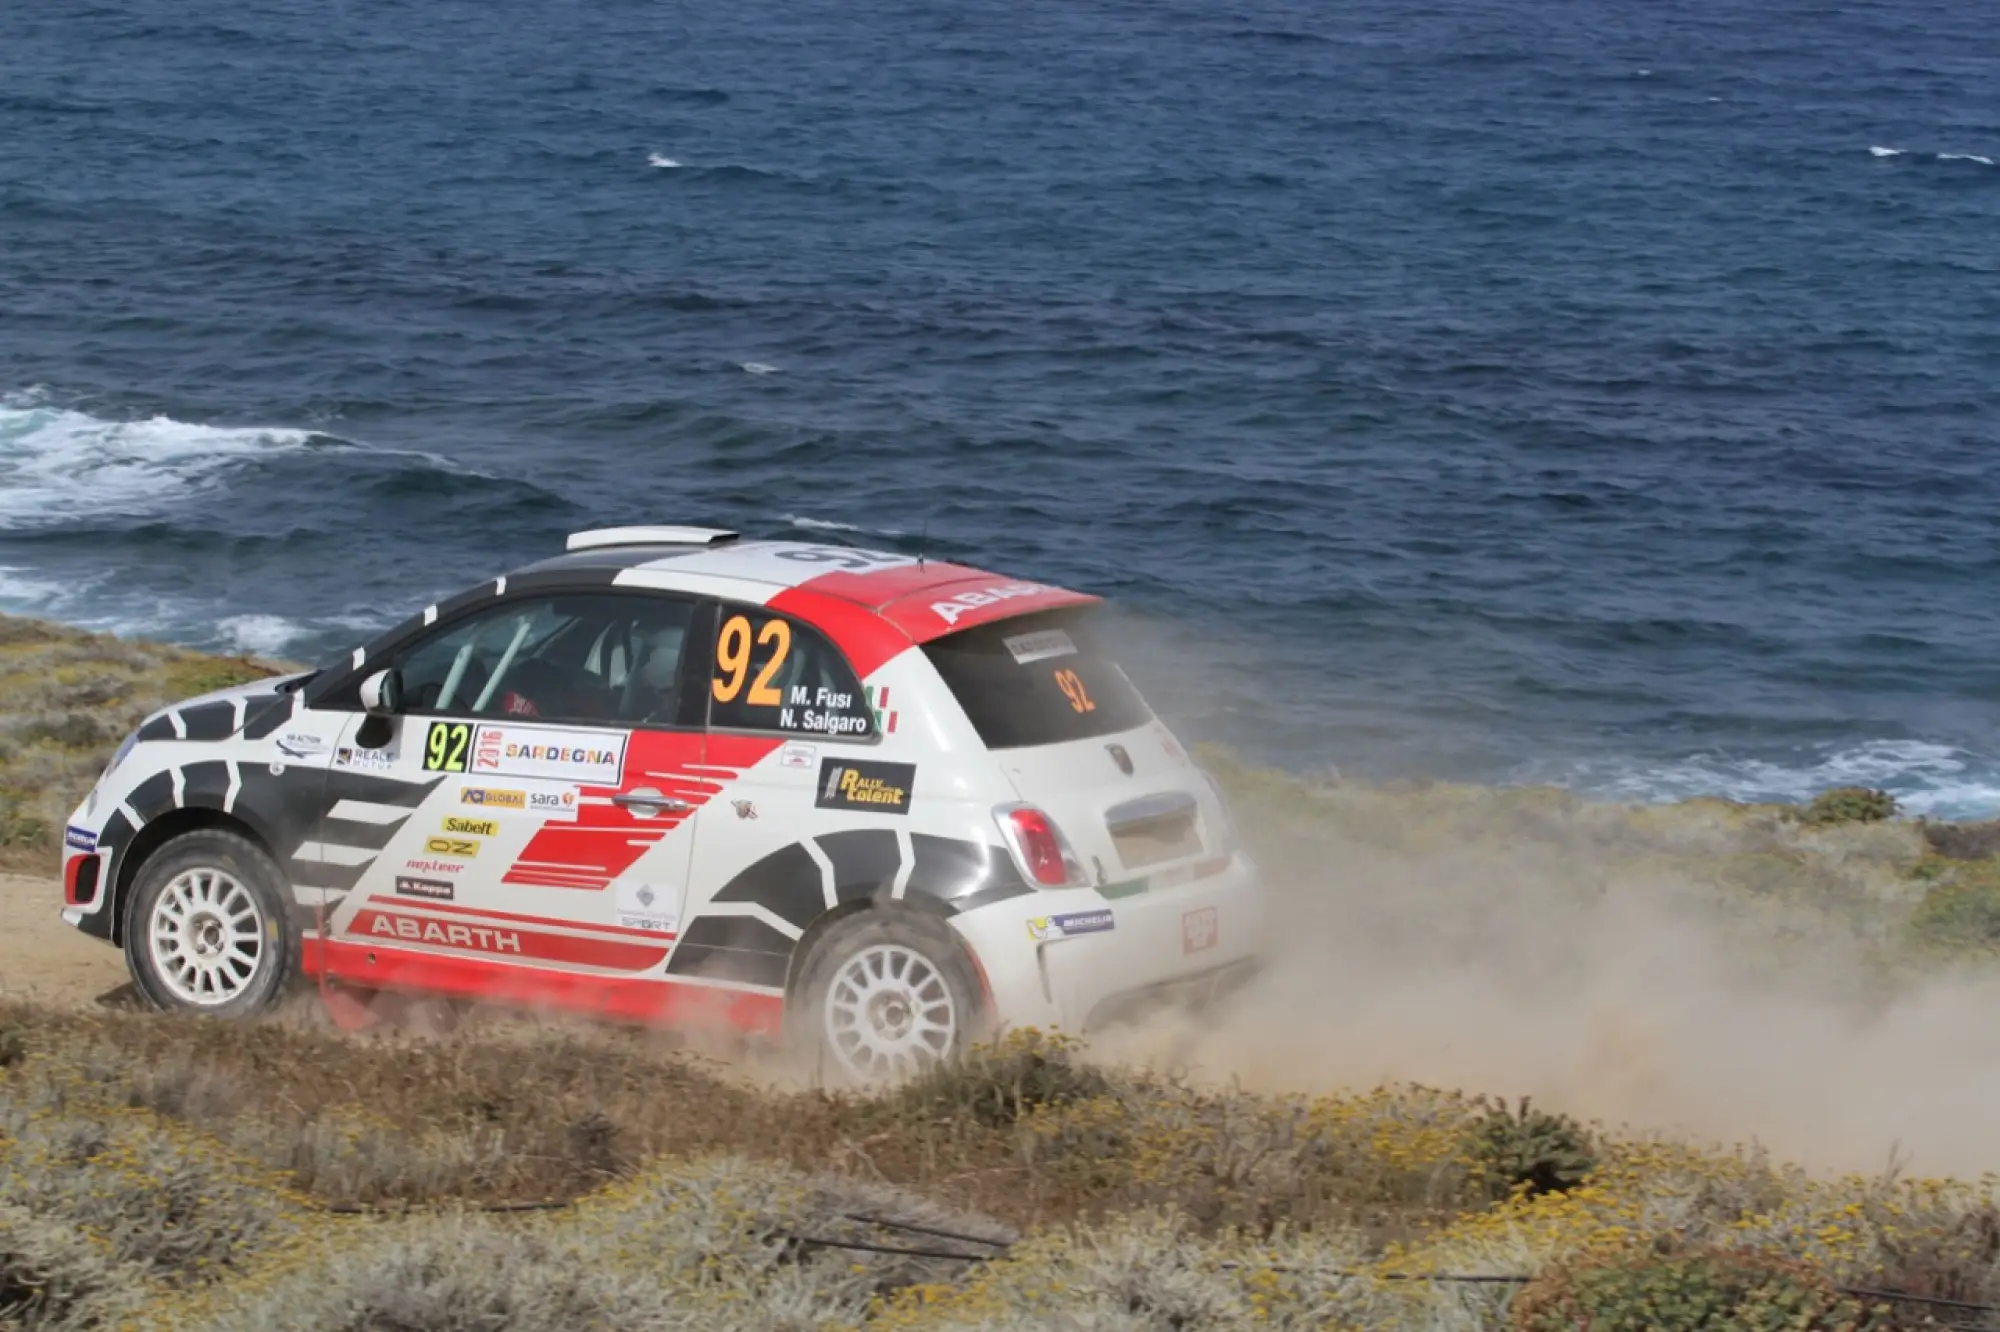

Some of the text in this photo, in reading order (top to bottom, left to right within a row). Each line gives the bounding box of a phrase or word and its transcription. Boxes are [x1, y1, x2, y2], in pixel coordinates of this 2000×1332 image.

[712, 615, 792, 706] 92
[790, 686, 852, 708] M. Fusi
[1054, 669, 1096, 713] 92
[780, 708, 867, 735] N. Salgaro
[355, 748, 394, 762] REALE
[427, 722, 468, 771] 92
[505, 743, 615, 765] SARDEGNA
[485, 792, 522, 806] GLOBAL
[530, 793, 559, 806] sara
[446, 817, 493, 836] Sabelt
[429, 839, 473, 855] OZ
[413, 881, 451, 895] Kappa
[371, 914, 521, 952] ABARTH
